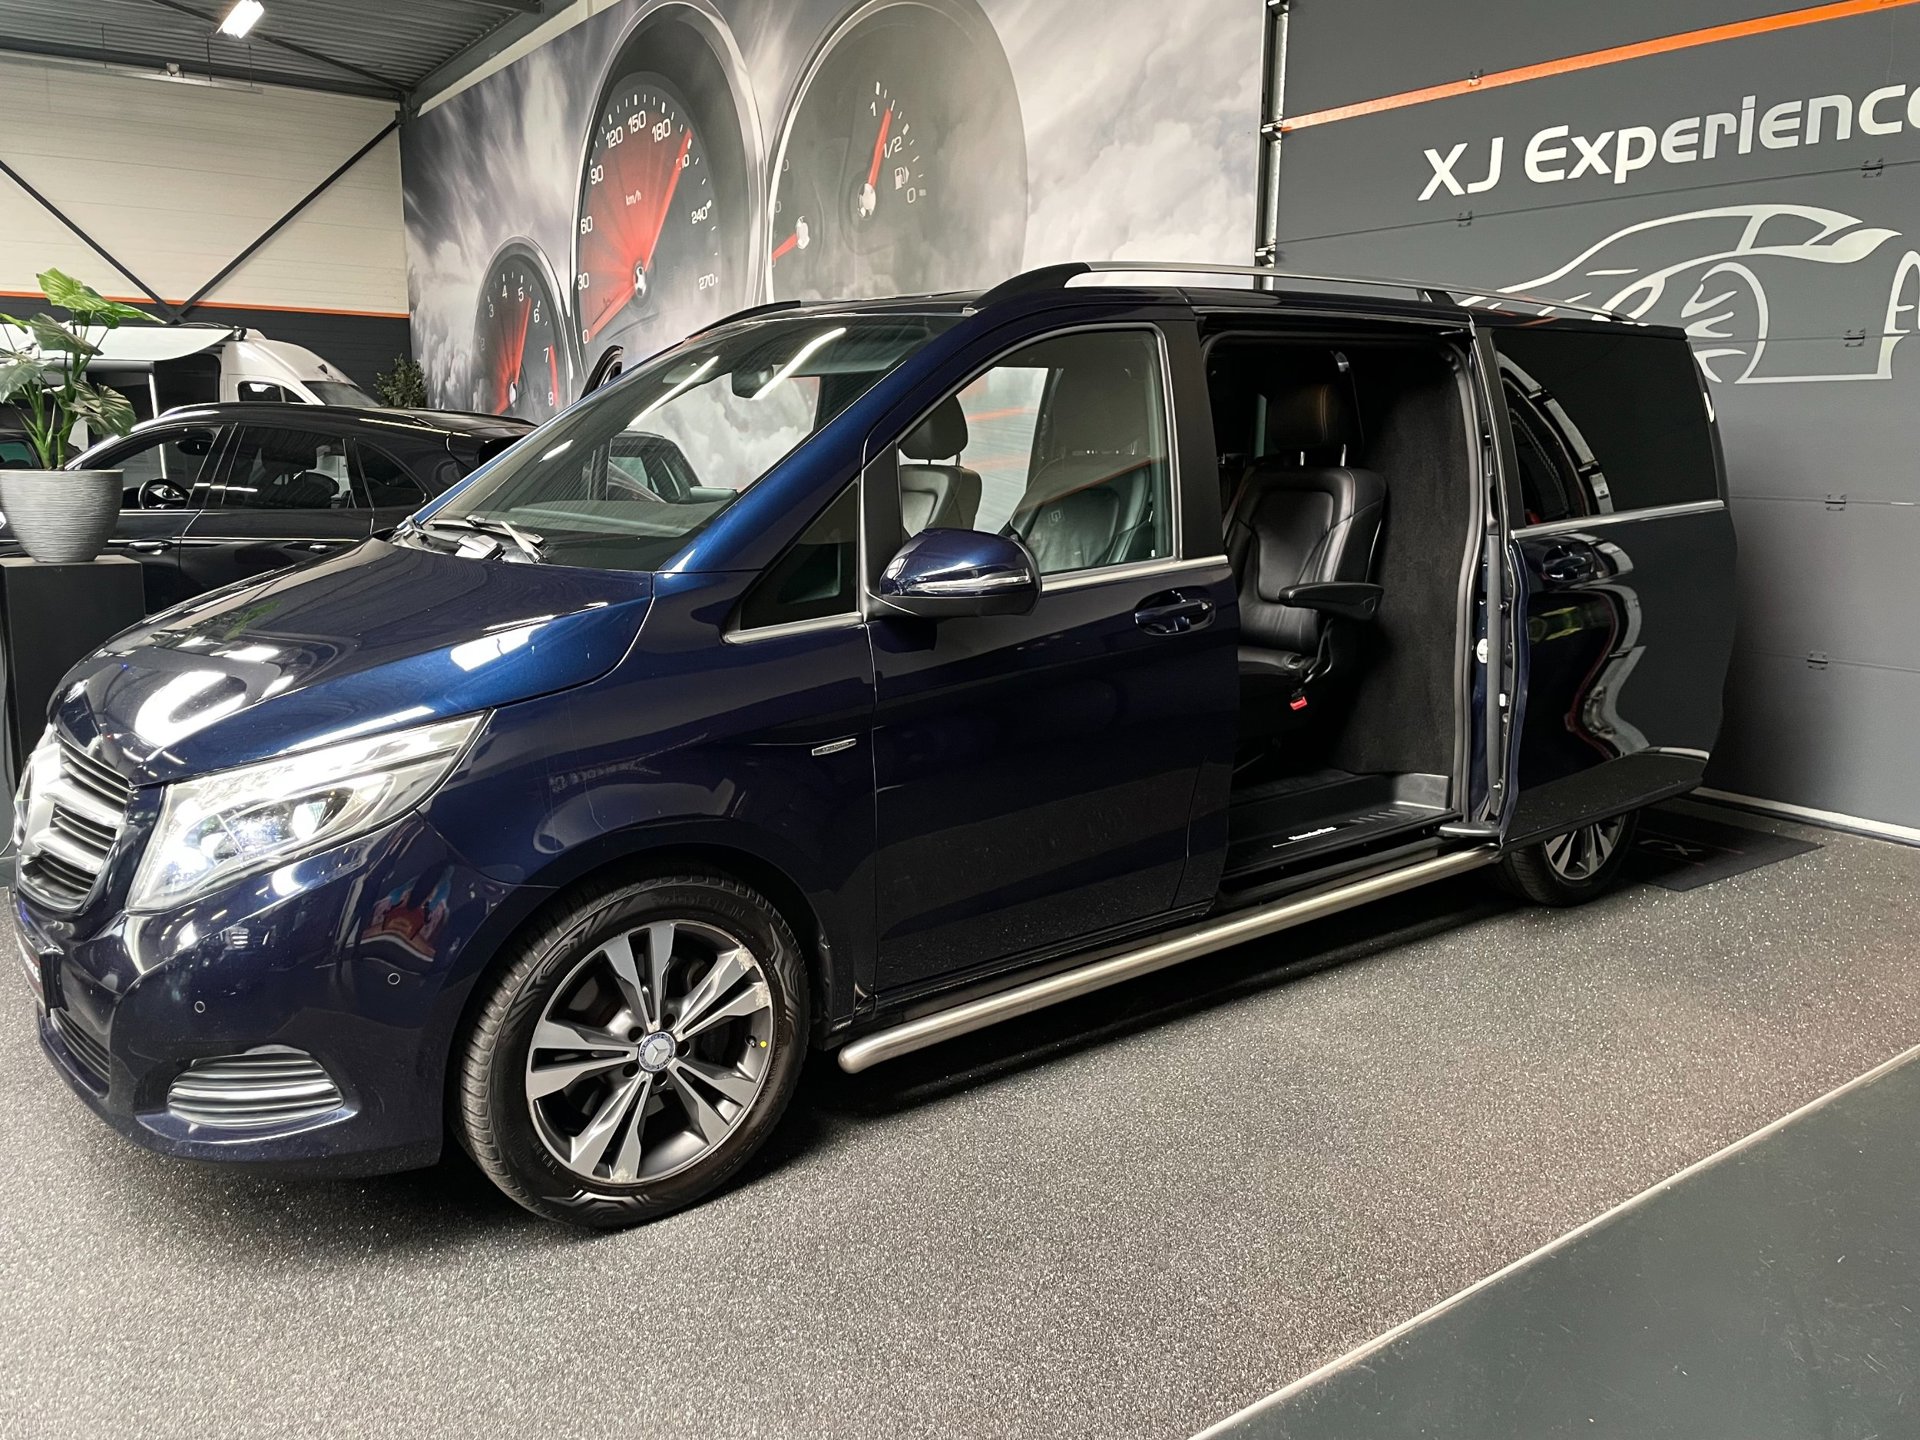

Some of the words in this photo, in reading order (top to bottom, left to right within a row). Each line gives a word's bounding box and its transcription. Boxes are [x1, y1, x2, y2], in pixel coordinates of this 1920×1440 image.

[628, 110, 647, 134] 150
[652, 118, 671, 143] 180
[606, 126, 624, 149] 120
[591, 165, 604, 185] 90
[1418, 136, 1504, 201] XJ
[626, 190, 642, 206] km/h
[907, 187, 917, 204] 0
[692, 207, 708, 225] 240
[581, 215, 593, 235] 60
[578, 271, 590, 291] 30
[699, 272, 715, 290] 270
[502, 285, 508, 299] 4
[517, 287, 525, 302] 5
[488, 304, 495, 318] 3
[533, 308, 540, 324] 6
[582, 329, 590, 345] 0
[543, 347, 550, 363] 7
[548, 391, 554, 407] 8
